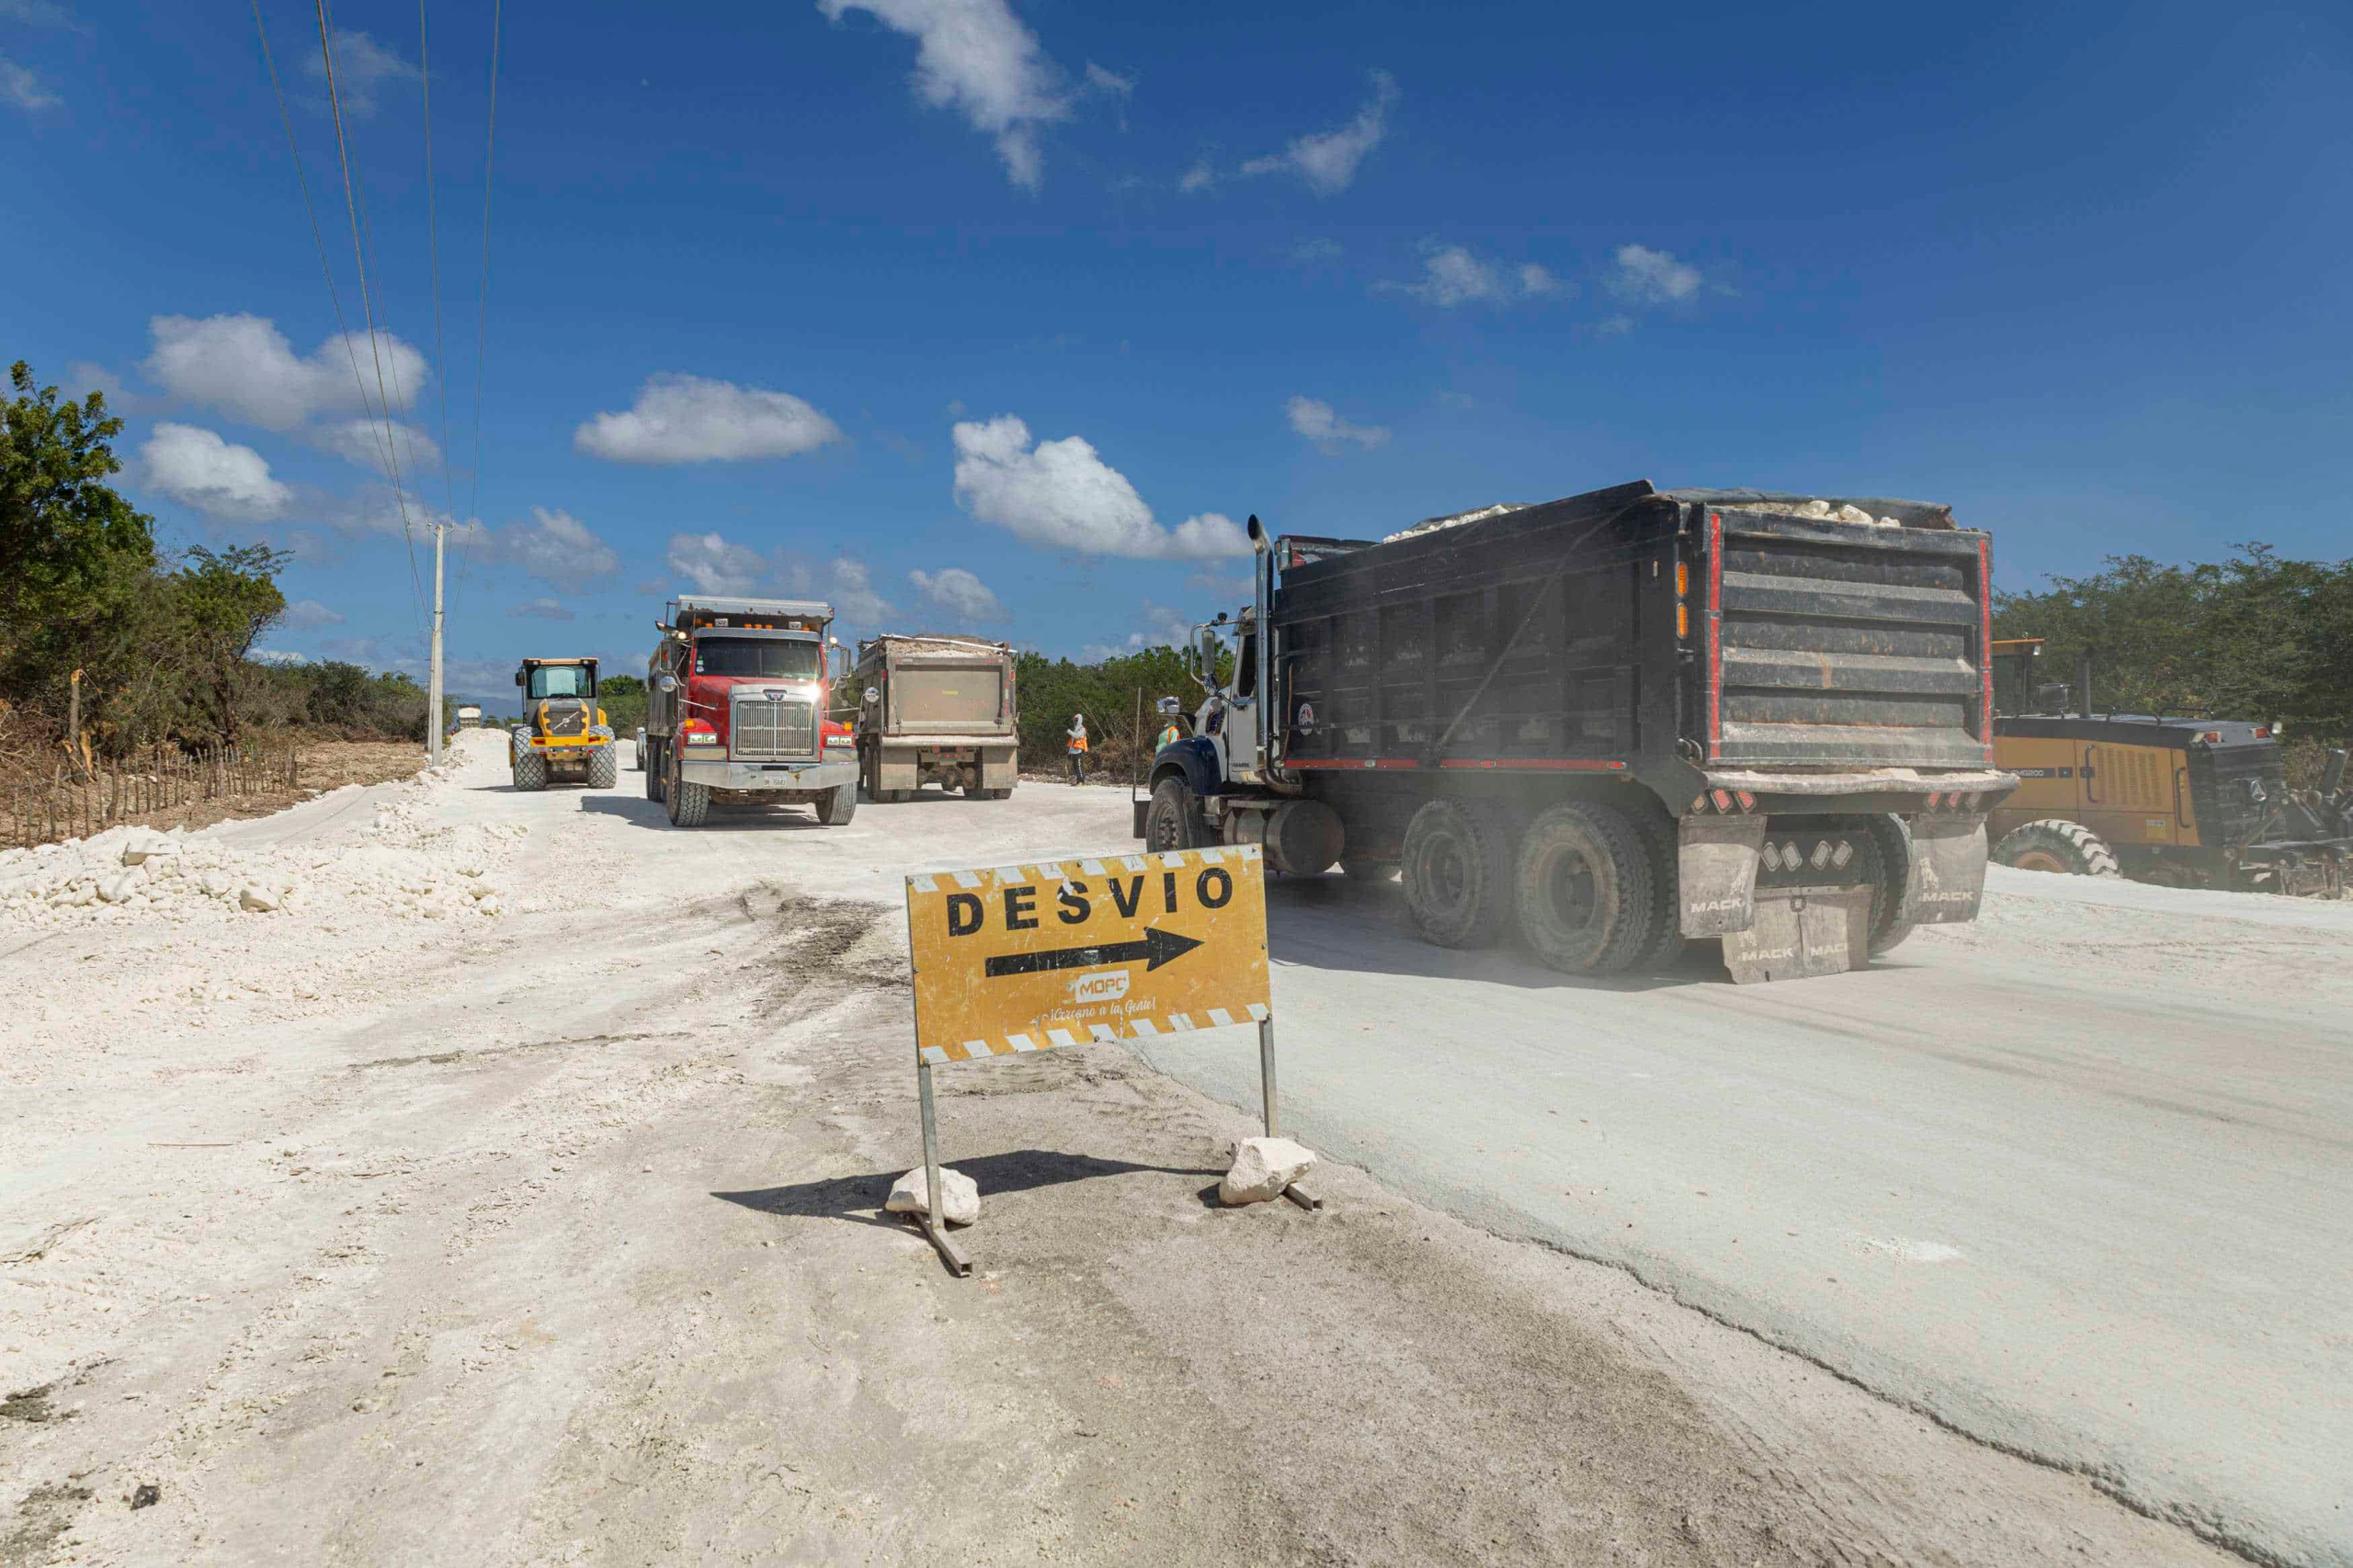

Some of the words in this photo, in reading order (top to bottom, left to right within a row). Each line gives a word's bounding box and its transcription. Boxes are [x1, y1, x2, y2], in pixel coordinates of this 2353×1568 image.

[946, 867, 1233, 937] DESVIO
[1918, 891, 1975, 903] MACK
[1690, 897, 1745, 914] MACK
[1741, 947, 1794, 961] MACK
[1079, 976, 1127, 995] MOPC
[1098, 1006, 1108, 1017] a
[1109, 1001, 1121, 1016] la
